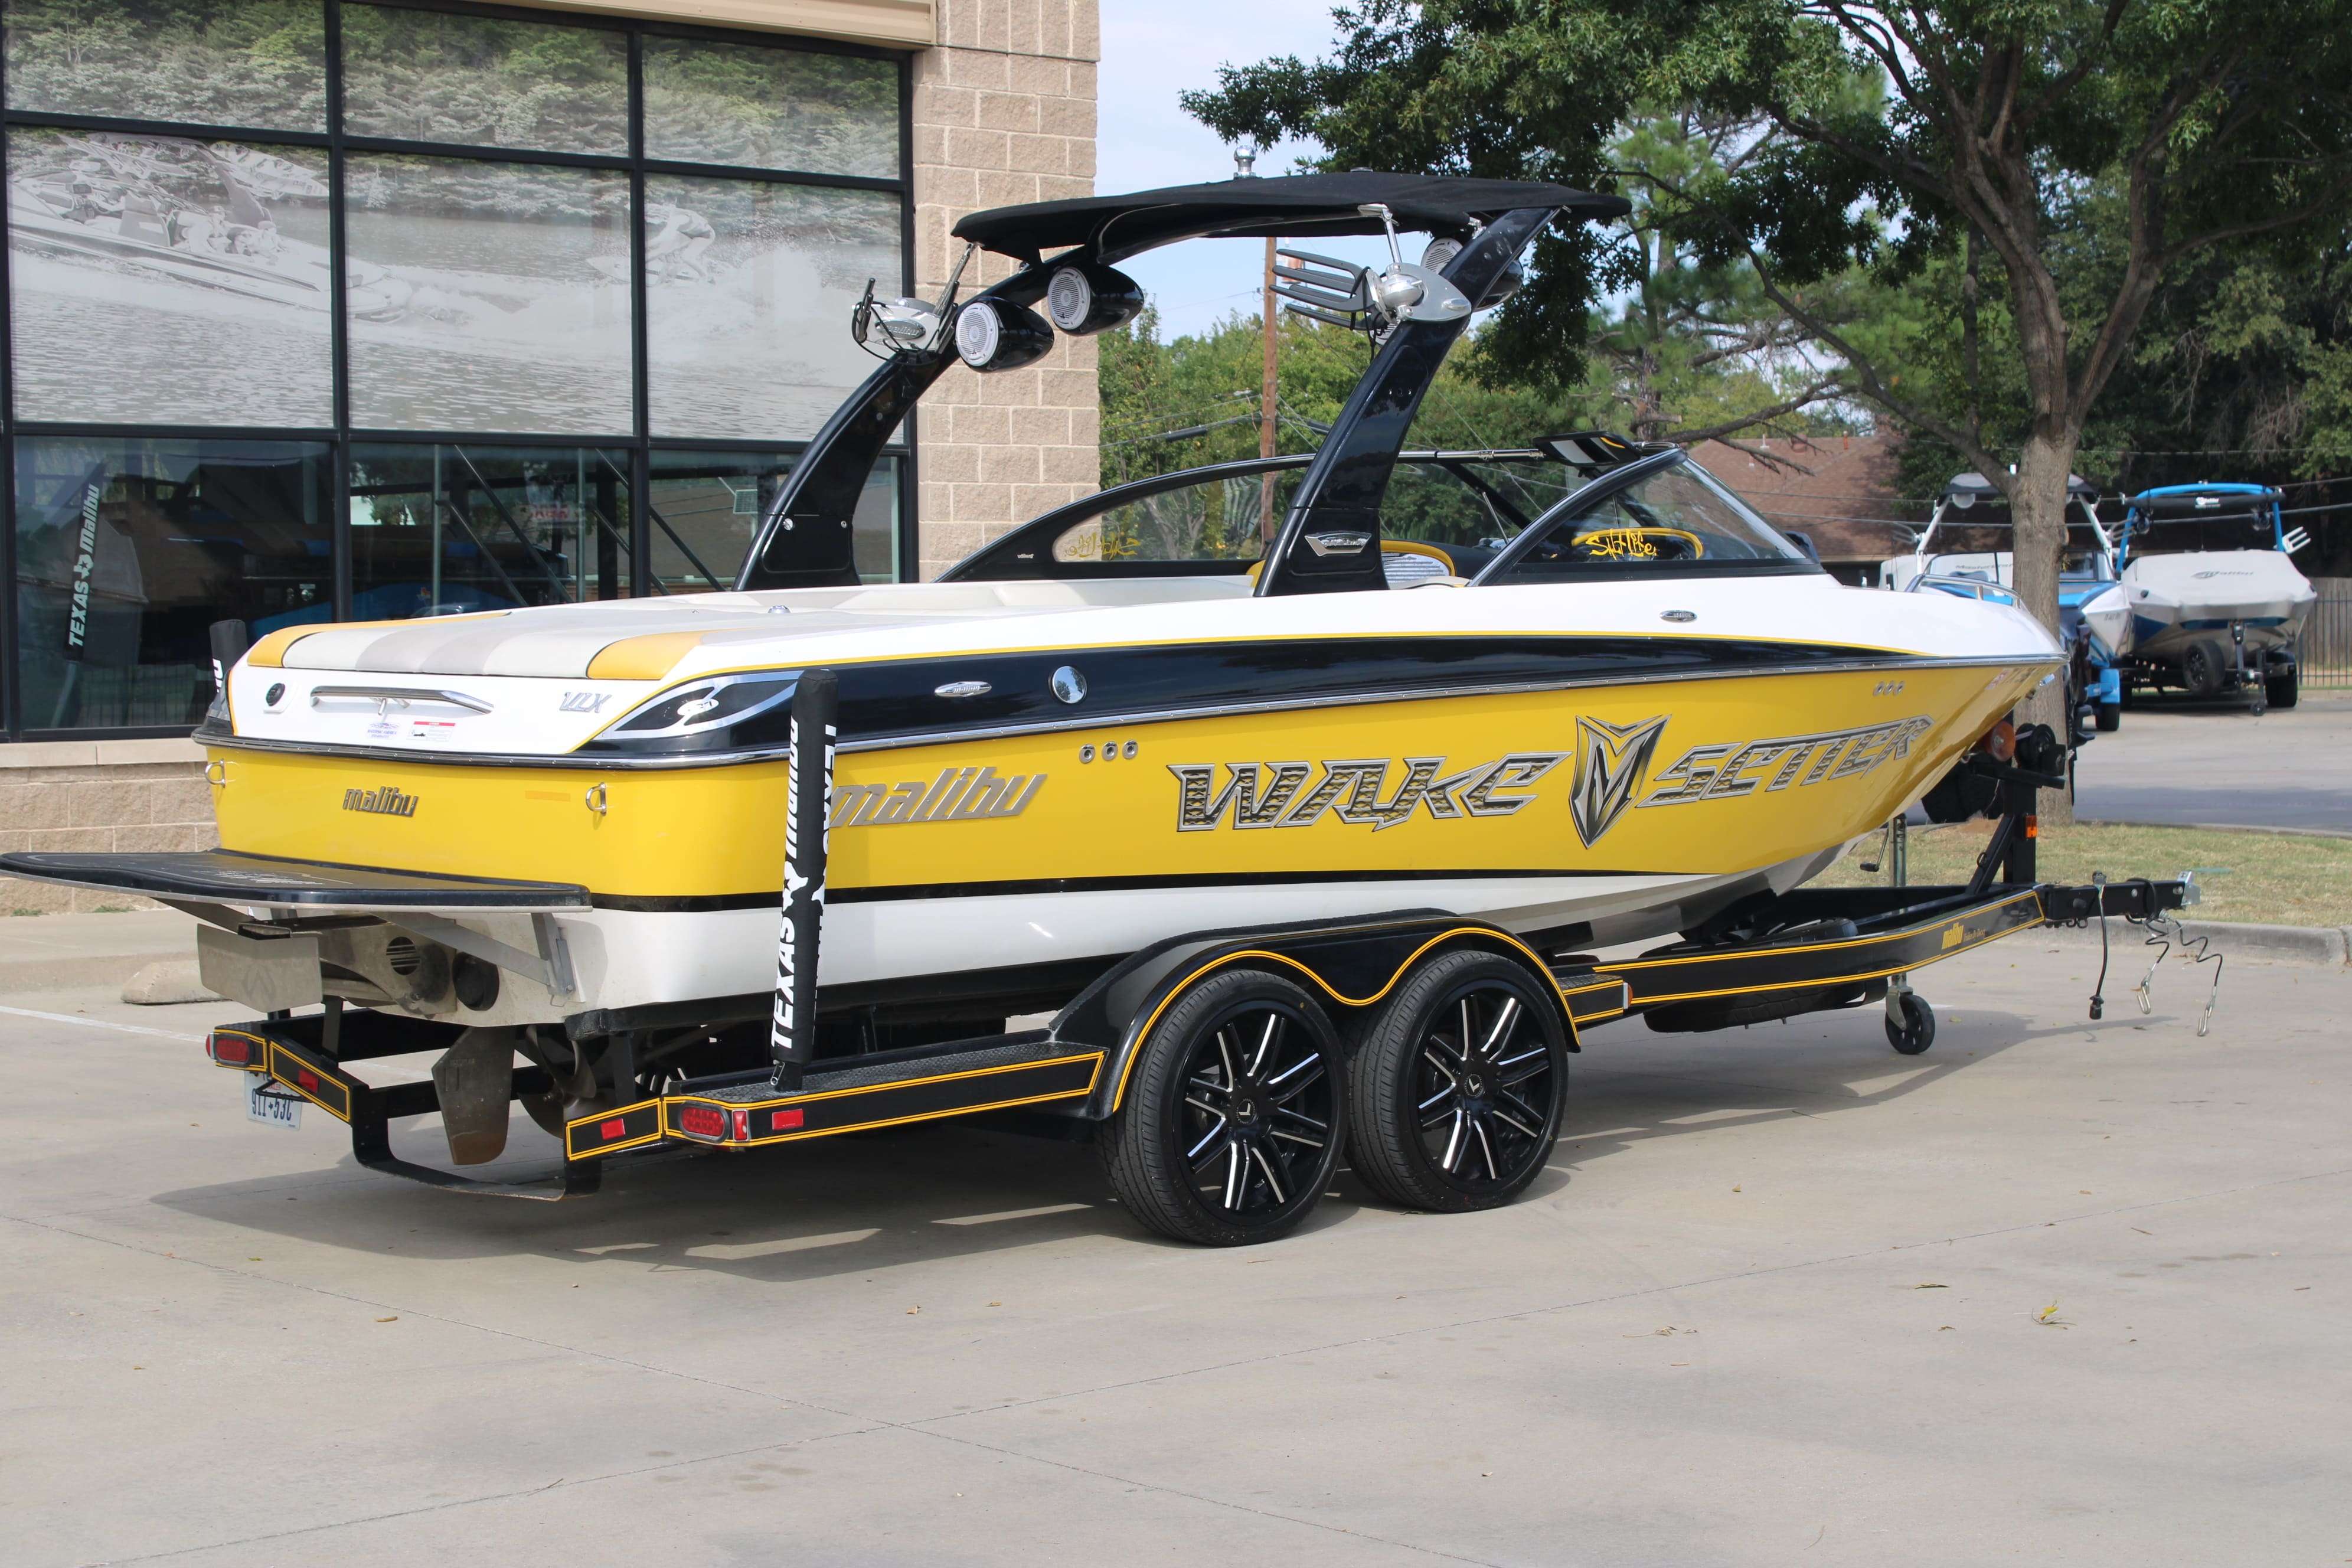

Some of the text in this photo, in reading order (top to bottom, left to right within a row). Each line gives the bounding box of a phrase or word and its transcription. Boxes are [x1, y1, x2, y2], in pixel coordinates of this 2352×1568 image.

[69, 580, 89, 646] TEXAS
[559, 692, 612, 713] VLX
[342, 786, 419, 817] malibu
[828, 767, 1047, 828] malibu
[771, 917, 795, 1048] TEXAS
